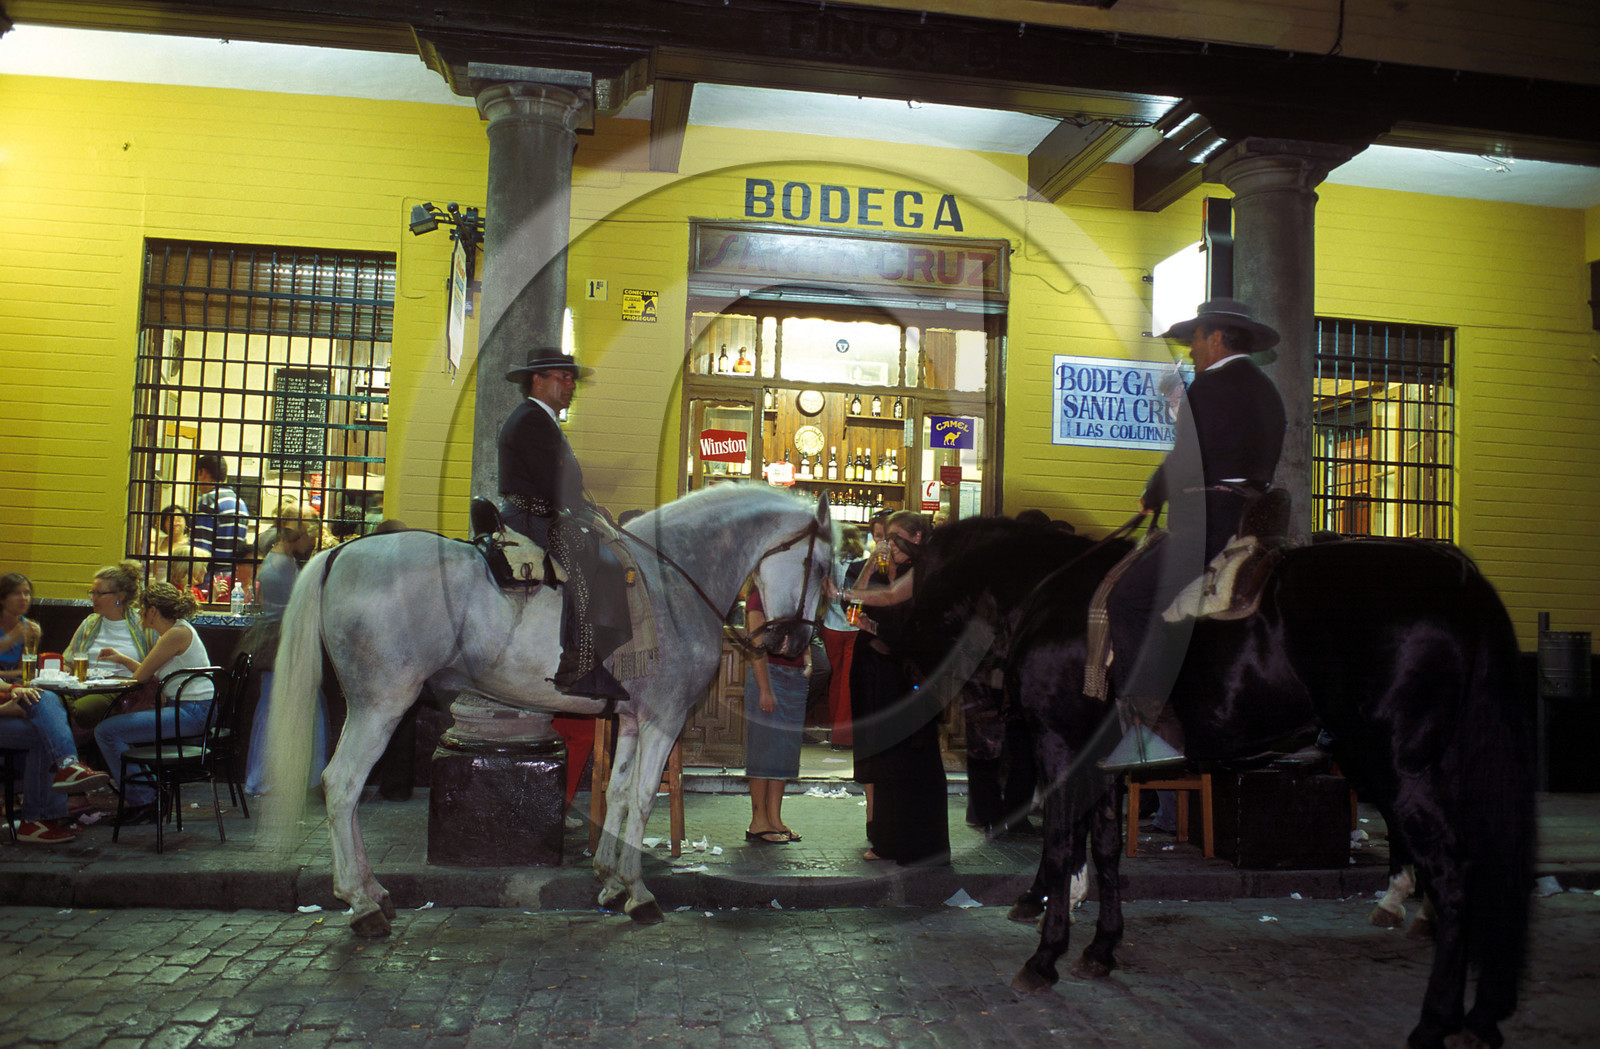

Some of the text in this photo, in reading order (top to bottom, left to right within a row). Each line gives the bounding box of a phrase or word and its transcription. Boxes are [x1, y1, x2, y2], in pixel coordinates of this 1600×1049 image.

[744, 177, 965, 232] BODEGA
[878, 246, 996, 287] CRUZ
[1056, 364, 1157, 397] BODEGA
[1063, 394, 1178, 426] SANTA CRU
[935, 420, 970, 433] CAMEL
[1075, 421, 1104, 438] LAS
[700, 437, 747, 456] Winston
